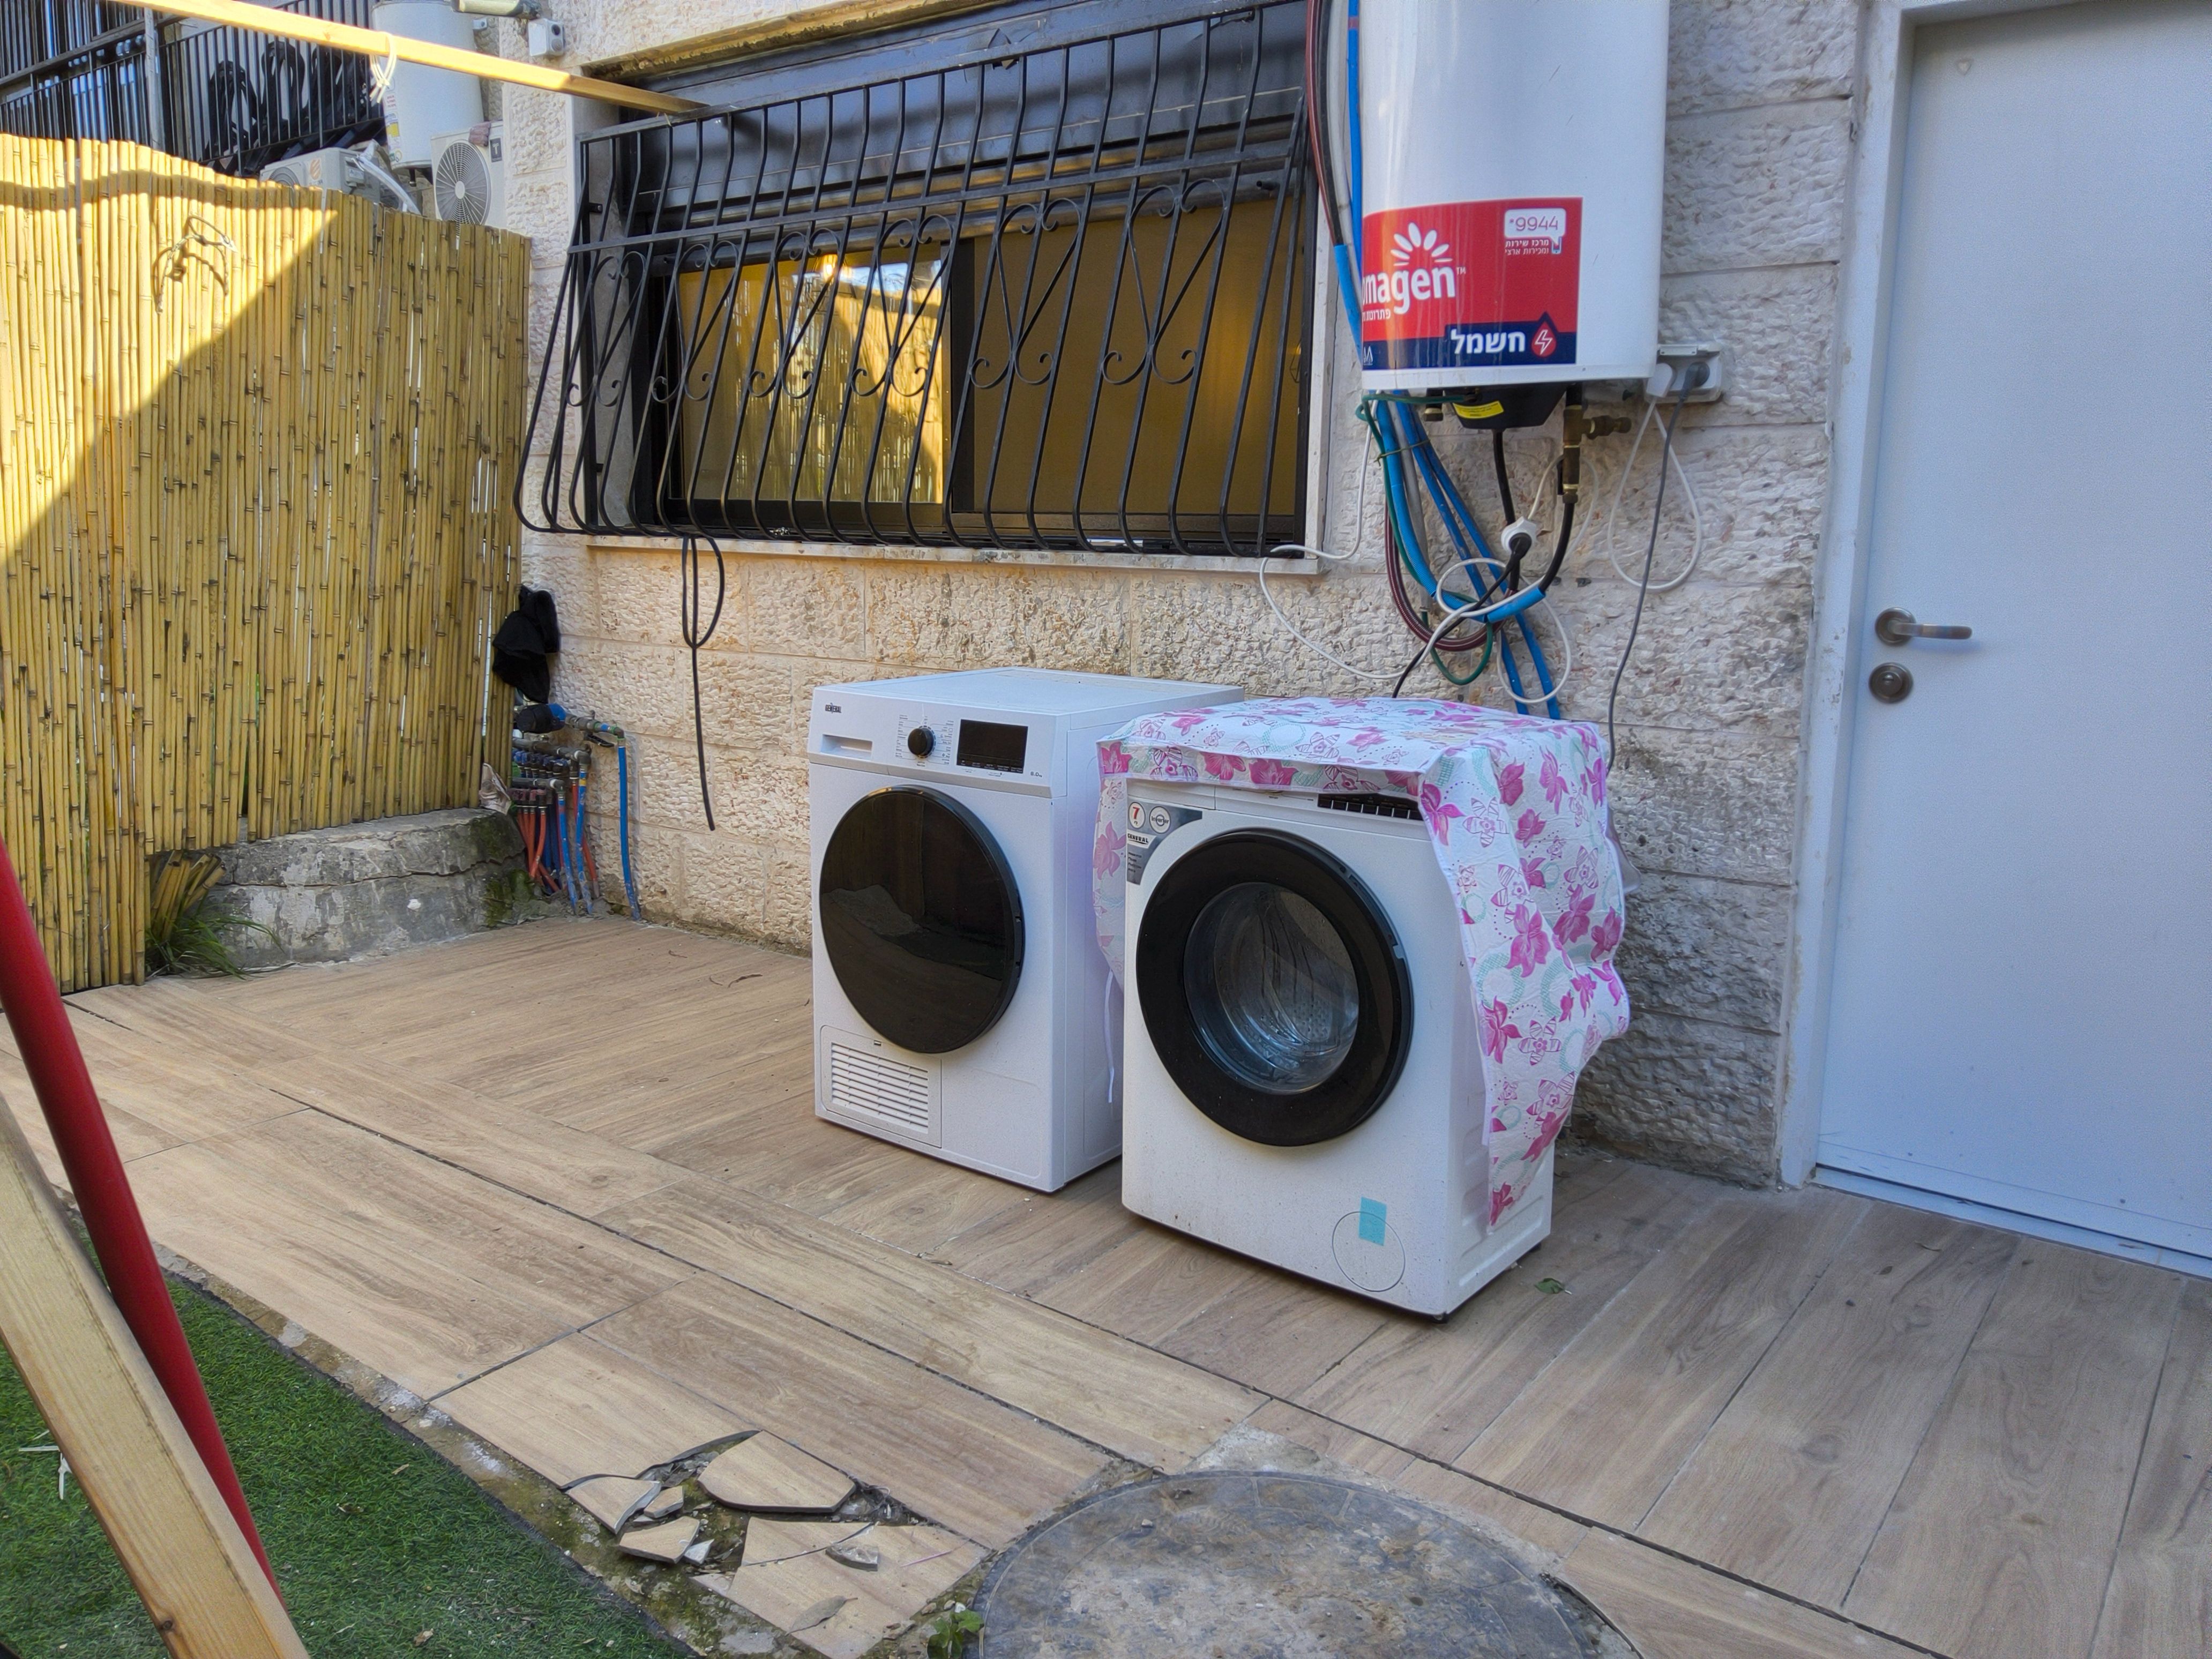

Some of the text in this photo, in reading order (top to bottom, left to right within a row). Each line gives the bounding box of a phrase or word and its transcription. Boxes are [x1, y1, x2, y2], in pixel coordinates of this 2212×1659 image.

[1451, 328, 1526, 354] חשמל
[1133, 806, 1140, 819] 7
[1151, 816, 1169, 824] Inverter
[1127, 833, 1148, 843] GENERAL
